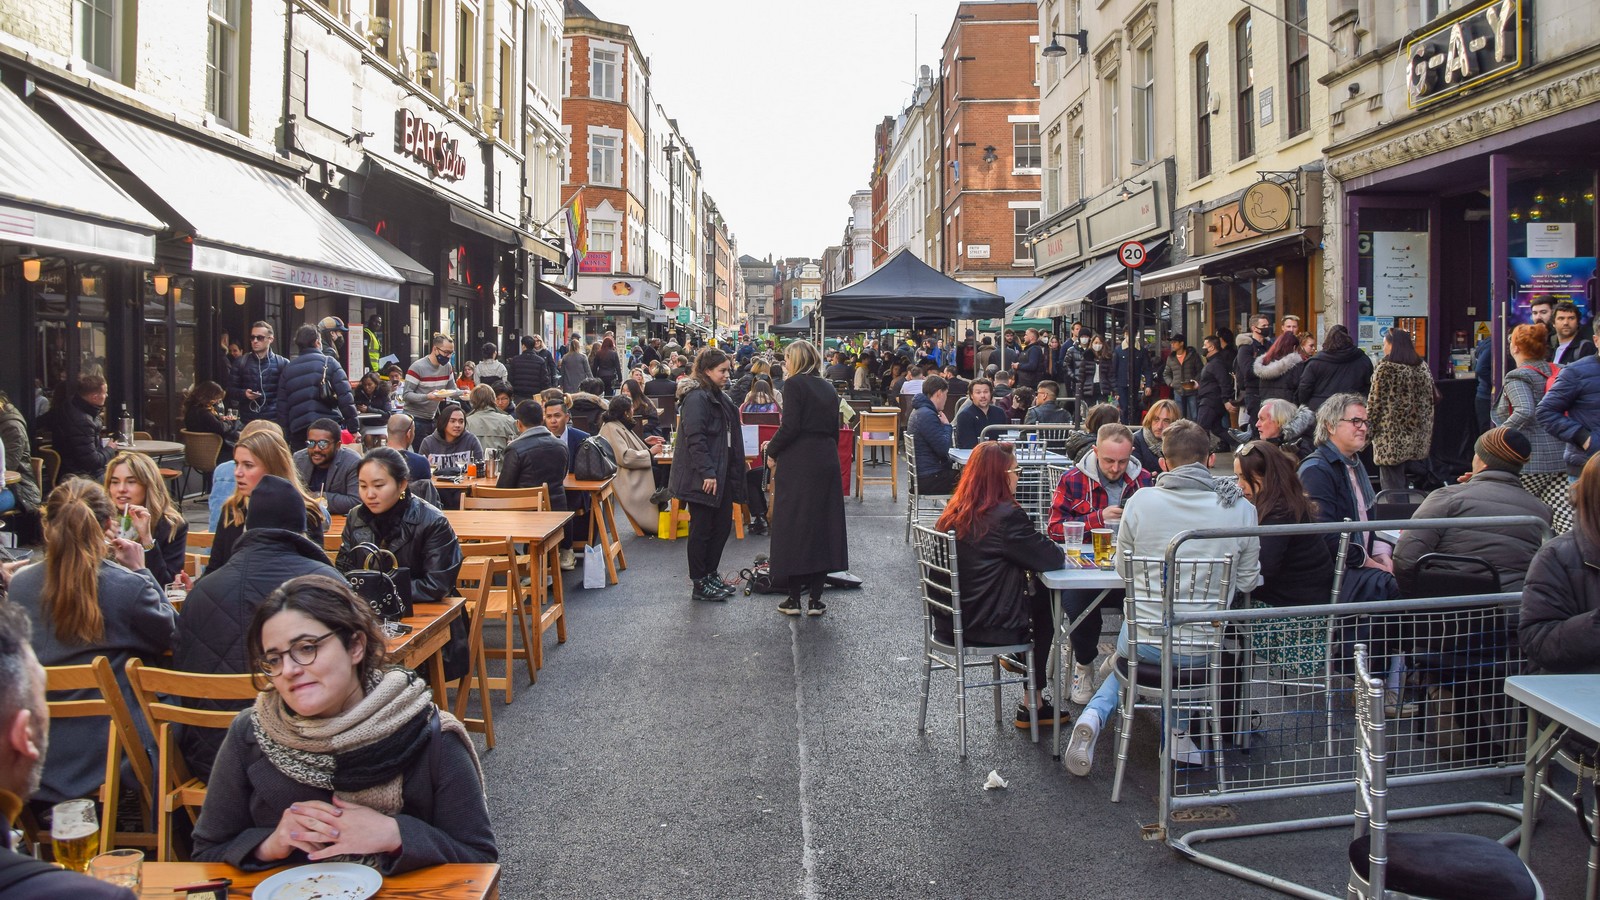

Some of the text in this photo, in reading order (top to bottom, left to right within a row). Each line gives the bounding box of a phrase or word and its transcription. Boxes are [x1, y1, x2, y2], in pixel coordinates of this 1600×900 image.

[1406, 0, 1516, 96] G-A-Y
[400, 107, 438, 166] BAR
[1180, 225, 1187, 250] 3
[1124, 248, 1143, 260] 20
[290, 268, 340, 289] PIZZA BAR
